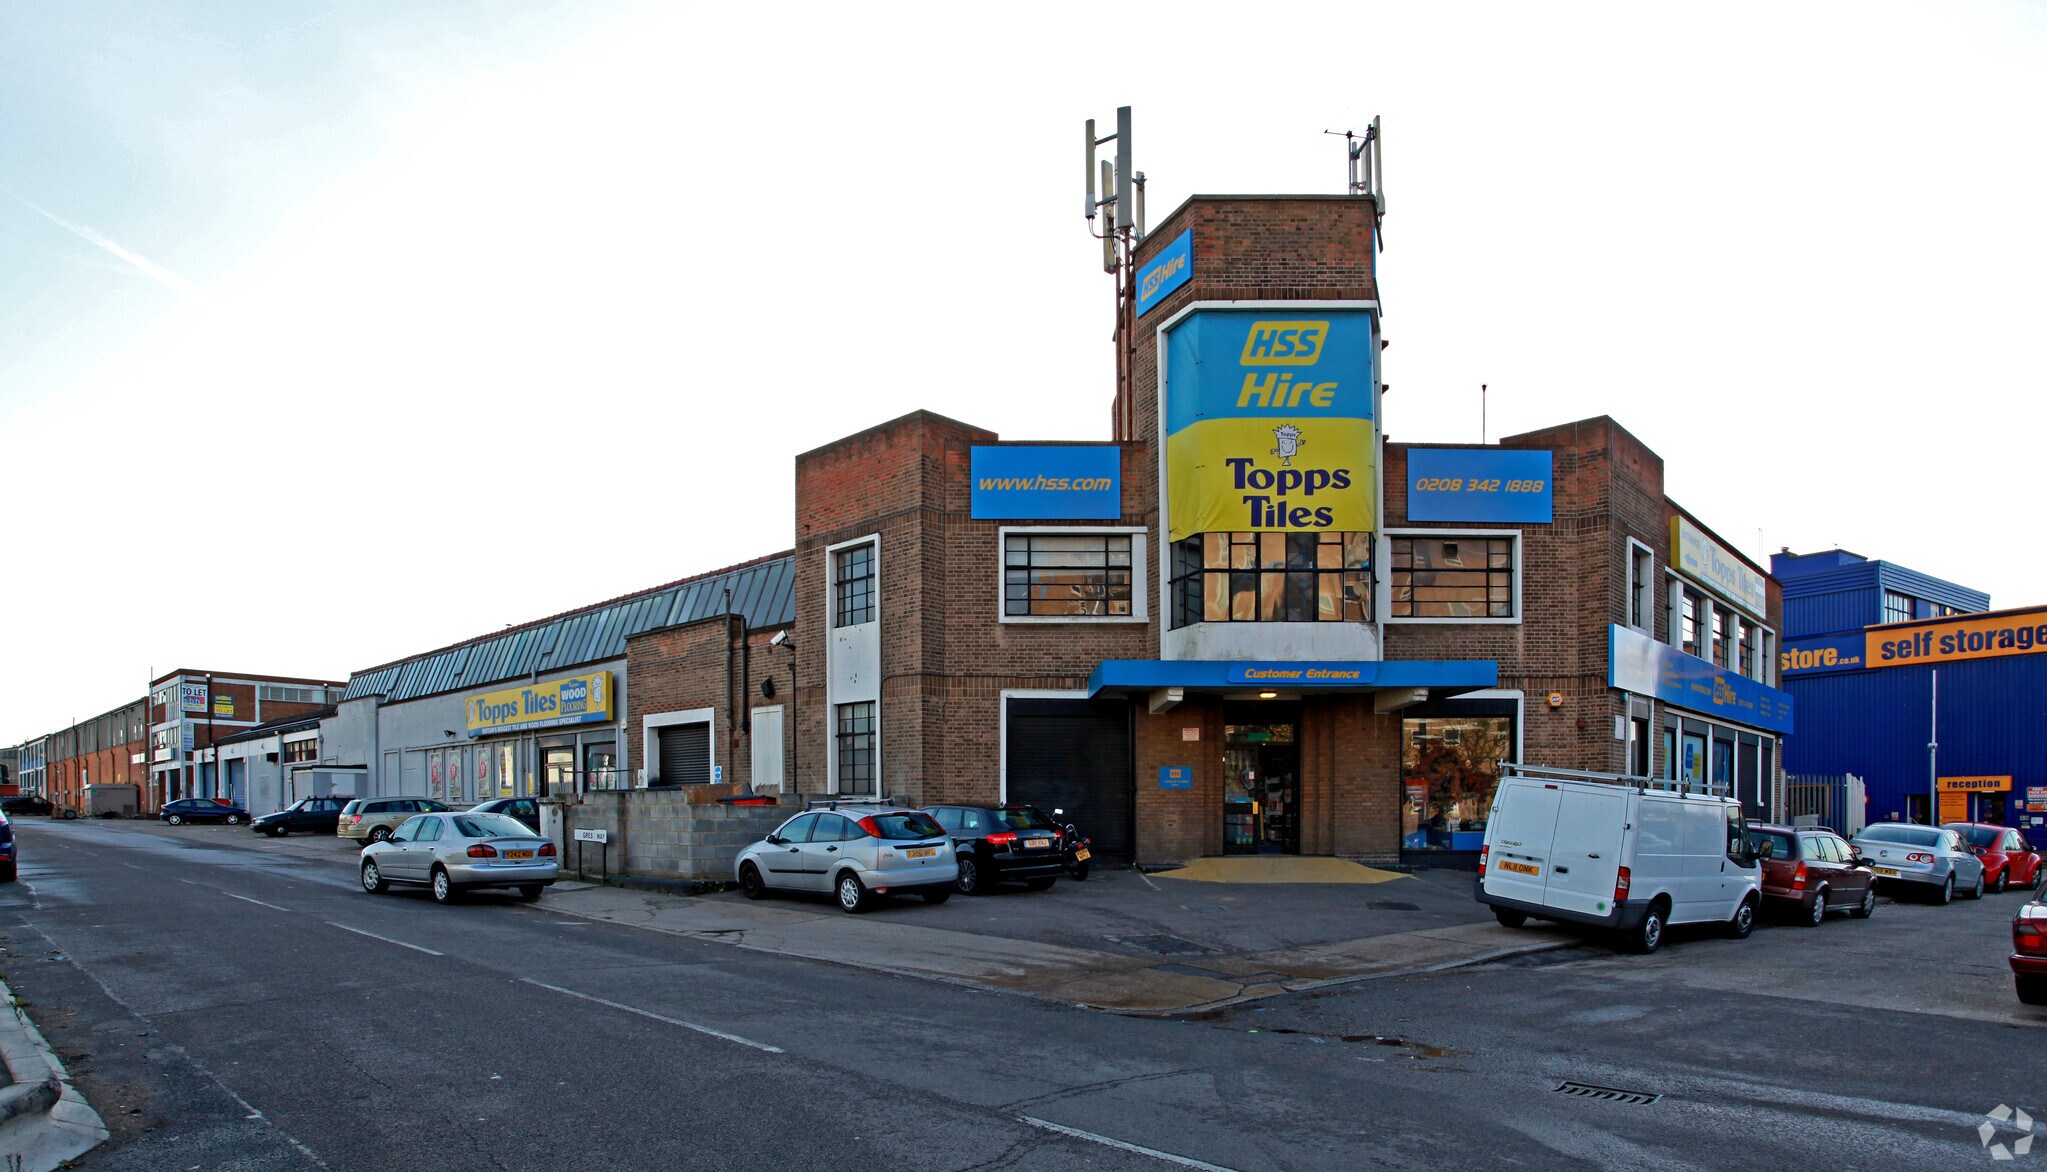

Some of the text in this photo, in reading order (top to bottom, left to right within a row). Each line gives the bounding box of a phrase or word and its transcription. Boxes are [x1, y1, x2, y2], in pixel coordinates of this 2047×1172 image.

[1142, 252, 1186, 297] HSS Hire
[1249, 328, 1321, 358] HSS
[1236, 373, 1339, 407] Hire
[979, 474, 1112, 491] www.hss.com
[1225, 458, 1351, 496] Topps
[1416, 478, 1545, 493] 0208 342 1888
[1242, 495, 1334, 528] Tiles
[1710, 545, 1735, 586] Topps
[1737, 564, 1754, 597] Tiles
[1881, 624, 2047, 660] self storage
[1245, 668, 1361, 679] Customer Entrance
[183, 688, 207, 697] TO LET
[561, 687, 587, 700] WOOD
[1724, 683, 1737, 706] Hire
[476, 689, 557, 724] Topps Tiles
[561, 700, 587, 712] FLOORING
[539, 720, 558, 728] FLOORING
[559, 716, 582, 725] SPECIALIST
[1947, 780, 2001, 789] reception
